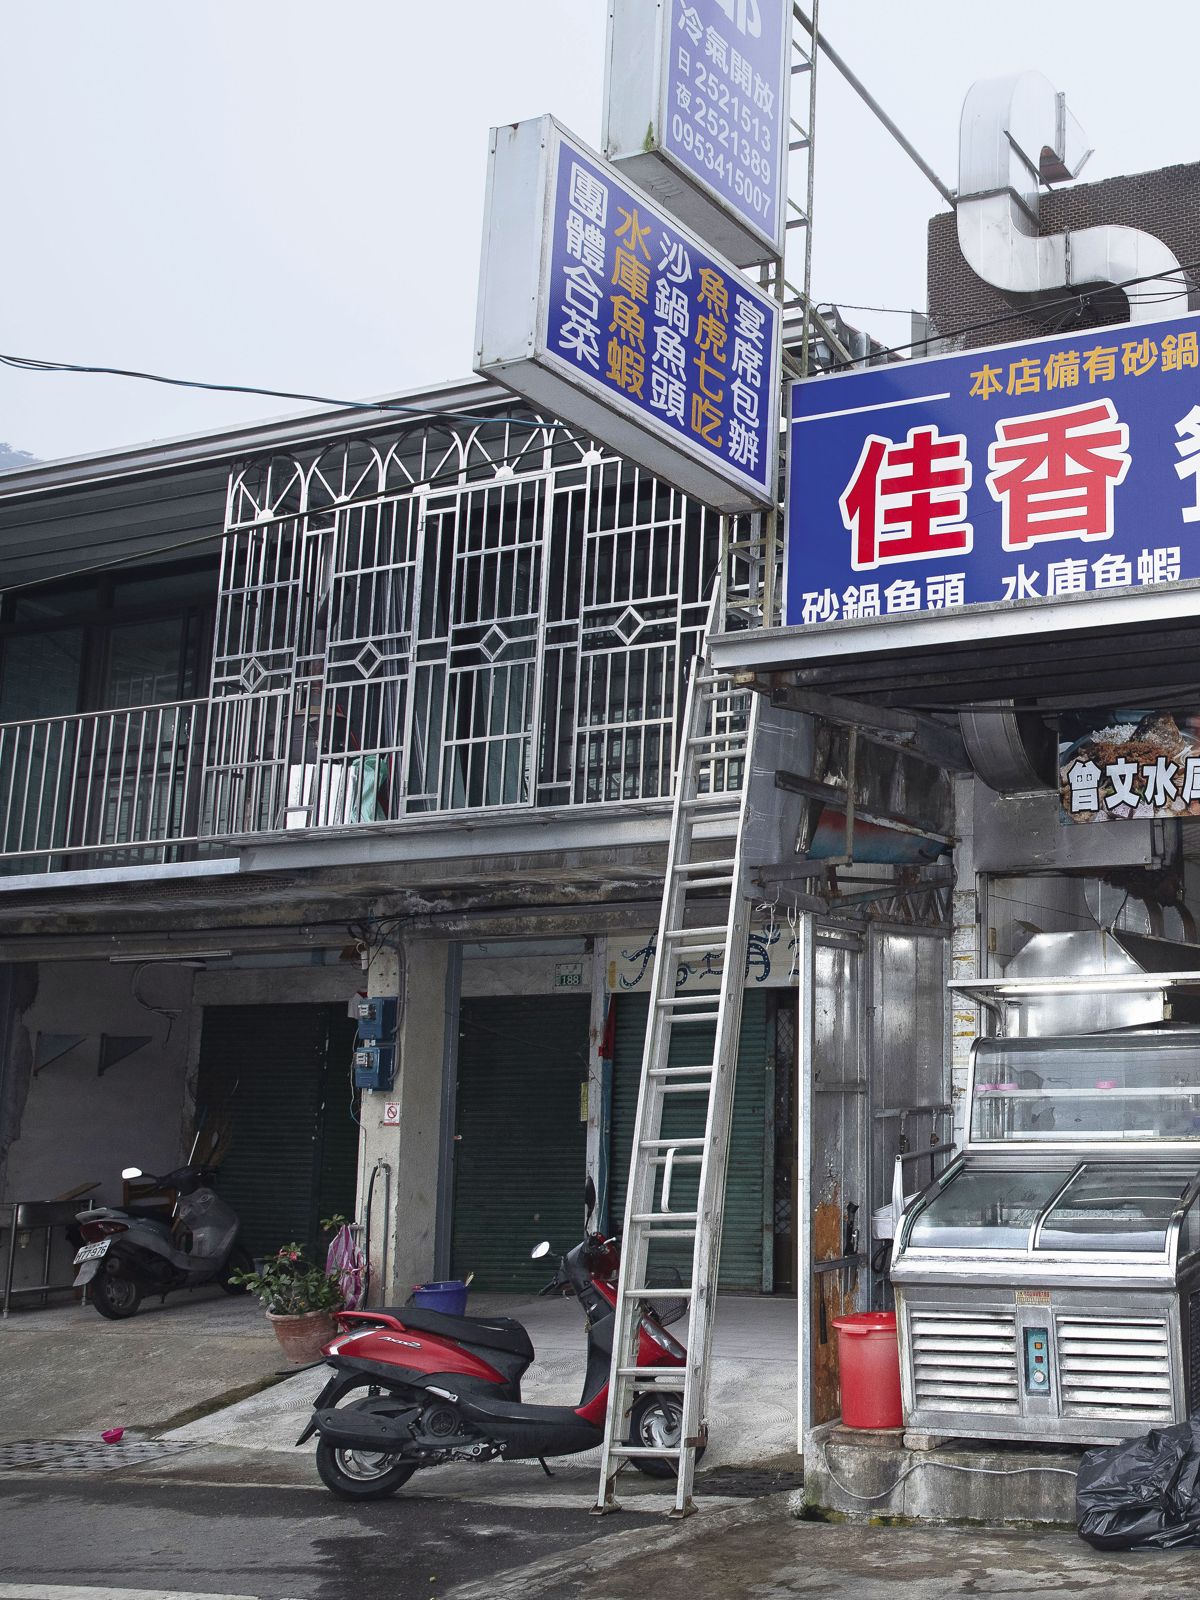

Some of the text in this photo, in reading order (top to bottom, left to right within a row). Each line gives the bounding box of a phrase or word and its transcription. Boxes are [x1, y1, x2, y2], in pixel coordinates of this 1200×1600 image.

[676, 81, 771, 185] 夜 2521389
[678, 0, 774, 120] 冷氣開放
[678, 46, 771, 152] 日 2521513
[672, 114, 771, 219] 0953415007
[558, 161, 608, 370] 團體合菜
[606, 206, 651, 400] 水庫魚蝦
[650, 231, 693, 426] 沙鍋魚頭
[690, 265, 730, 448] 魚虎七吃
[729, 293, 765, 471] 宴席包辦
[563, 975, 579, 985] 188
